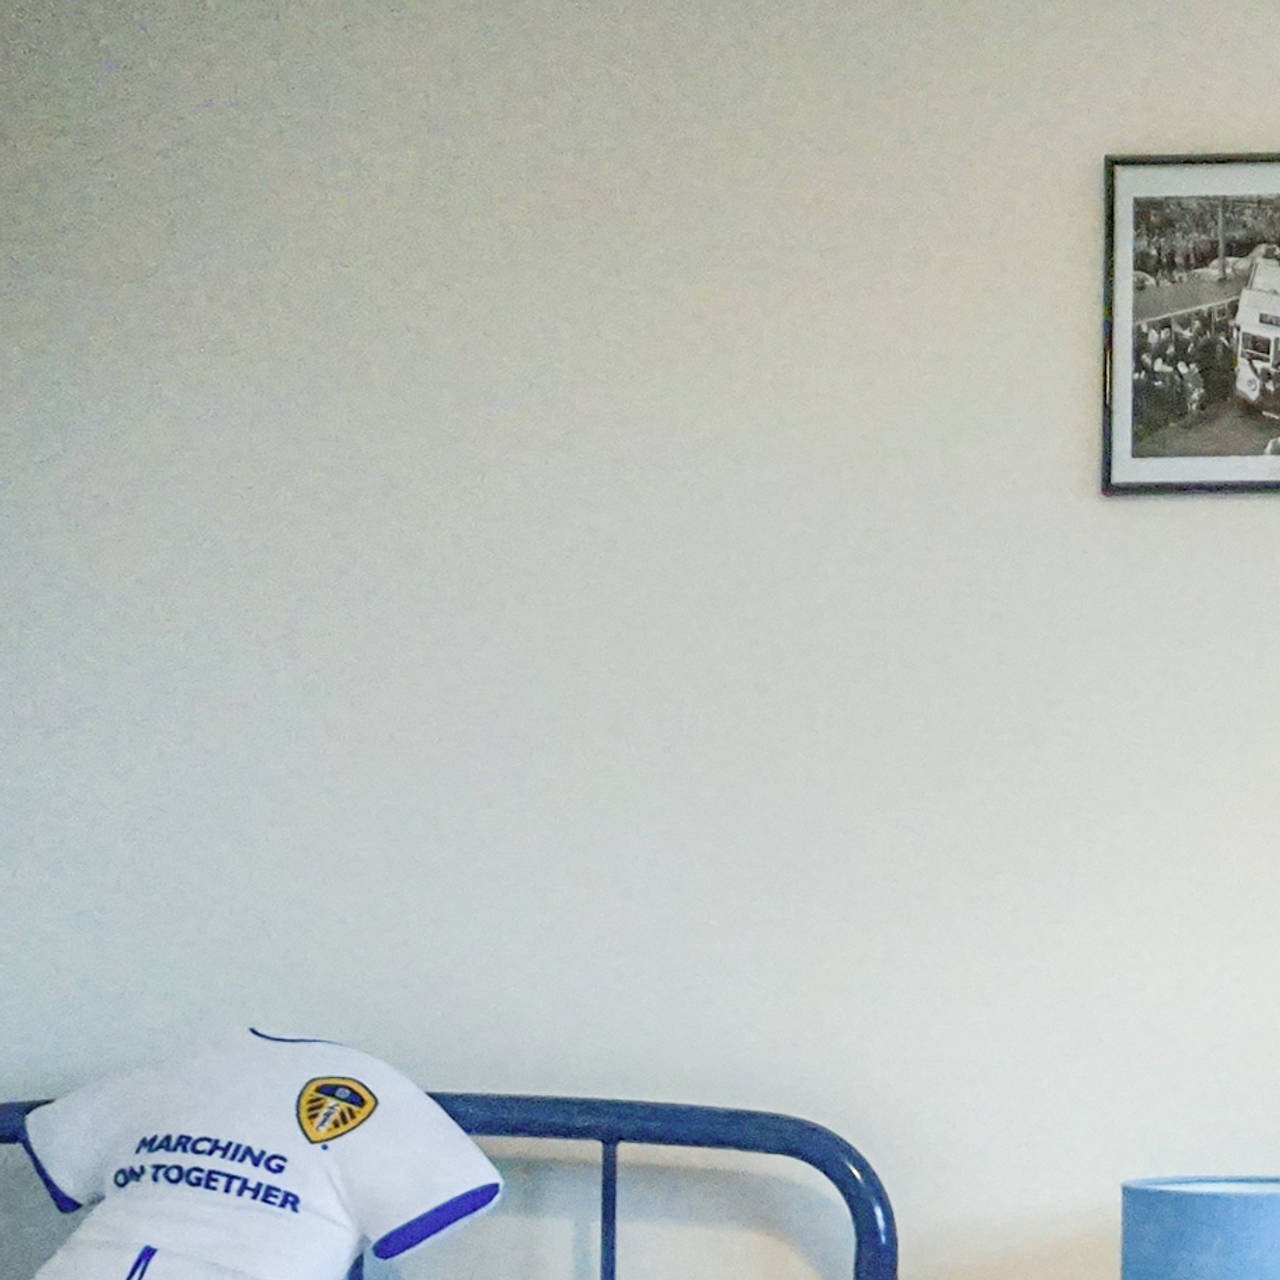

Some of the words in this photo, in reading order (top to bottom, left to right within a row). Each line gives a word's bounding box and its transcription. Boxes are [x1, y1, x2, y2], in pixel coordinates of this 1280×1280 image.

[135, 1134, 288, 1174] MARCHING
[114, 1165, 146, 1188] ON
[151, 1164, 300, 1213] TOGETHER
